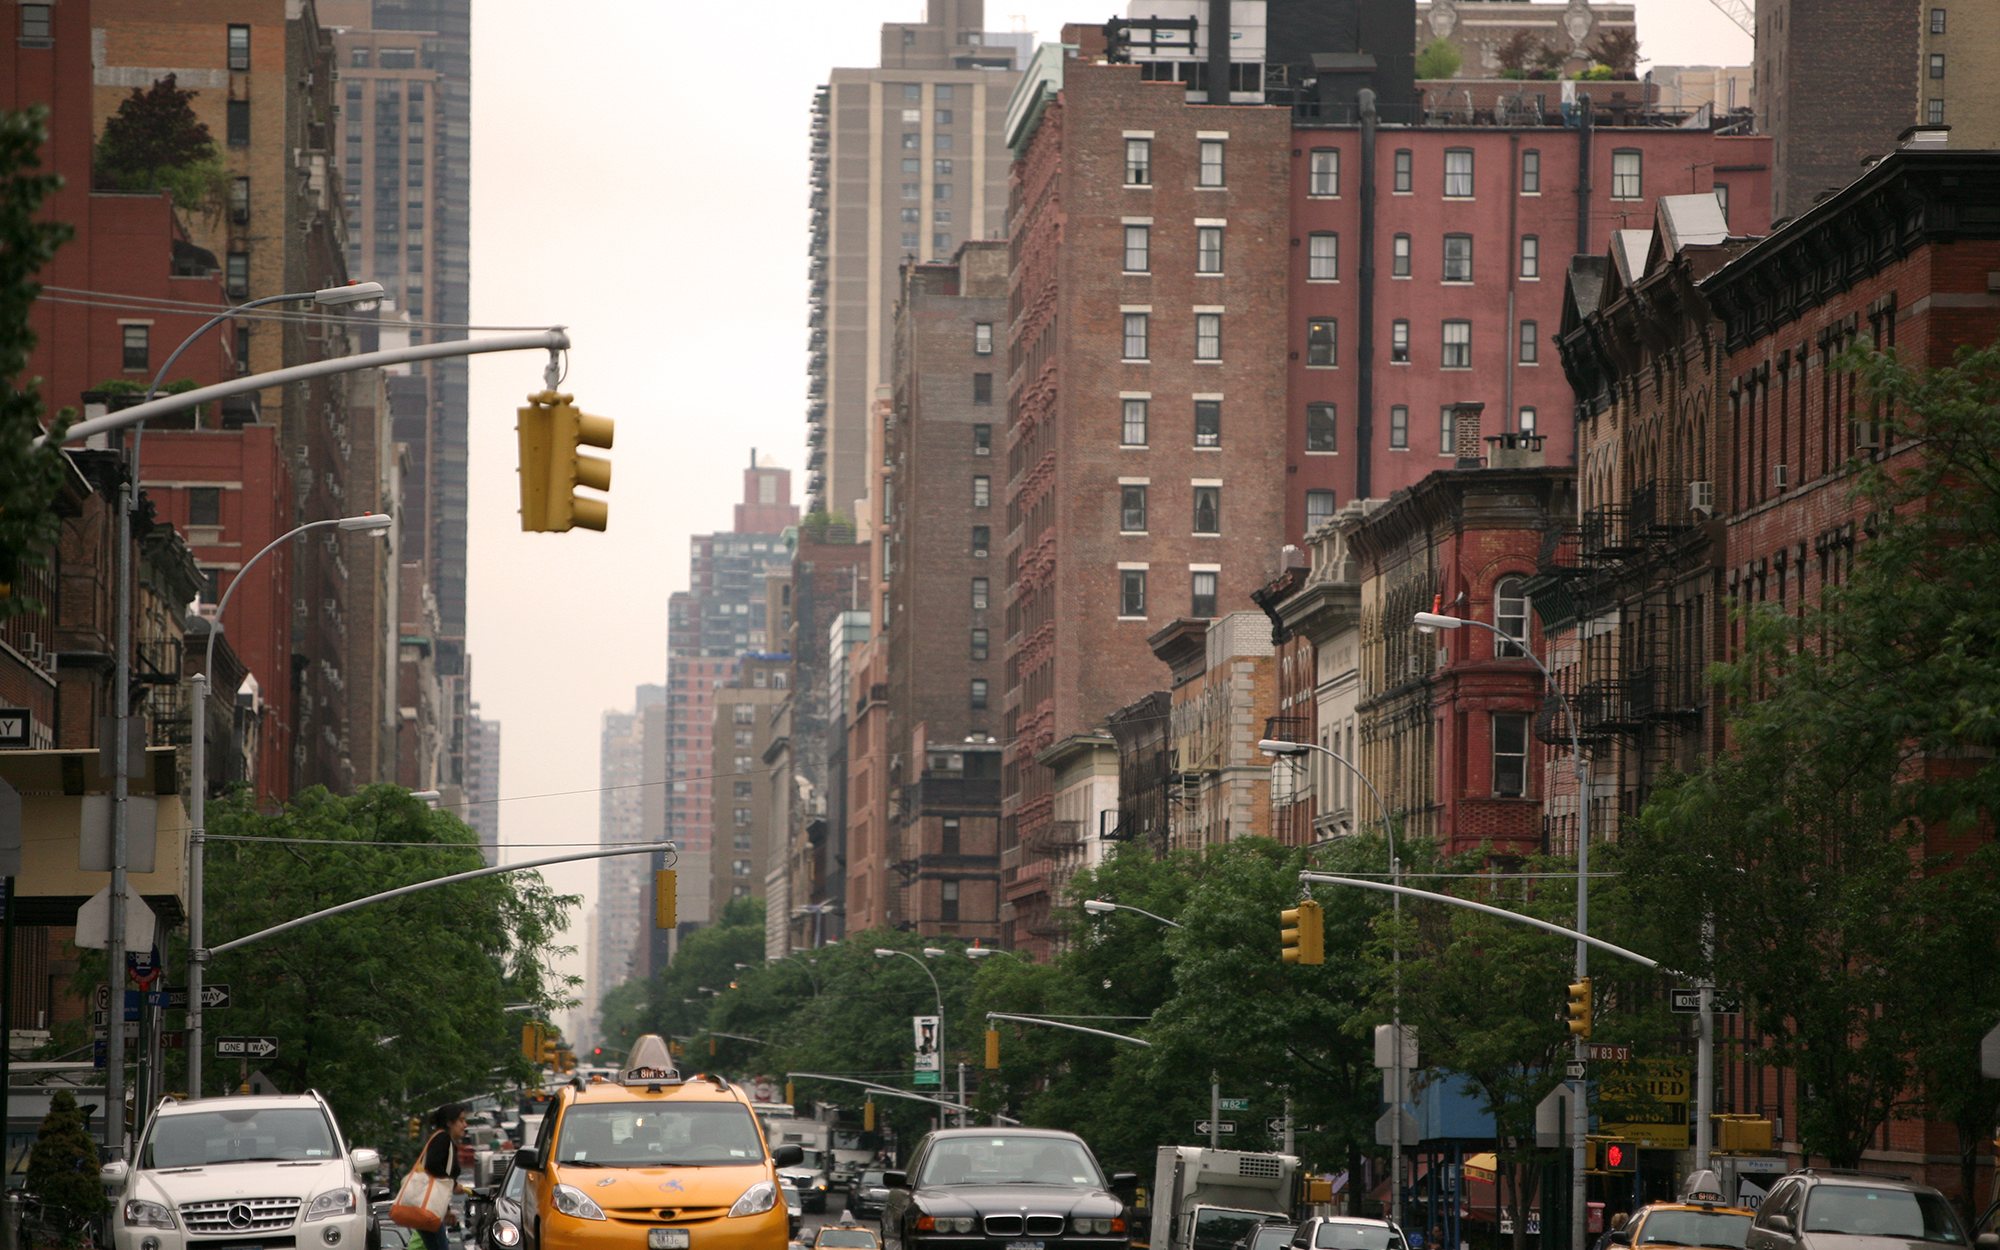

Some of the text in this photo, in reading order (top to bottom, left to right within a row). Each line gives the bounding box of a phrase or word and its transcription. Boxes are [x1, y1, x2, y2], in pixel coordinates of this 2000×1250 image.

[148, 993, 161, 1004] M7
[201, 993, 220, 1002] WAY
[161, 1033, 174, 1048] ST
[224, 1043, 270, 1052] ONE WAY
[1590, 1047, 1628, 1060] W 83 ST
[1229, 1100, 1240, 1109] 82
